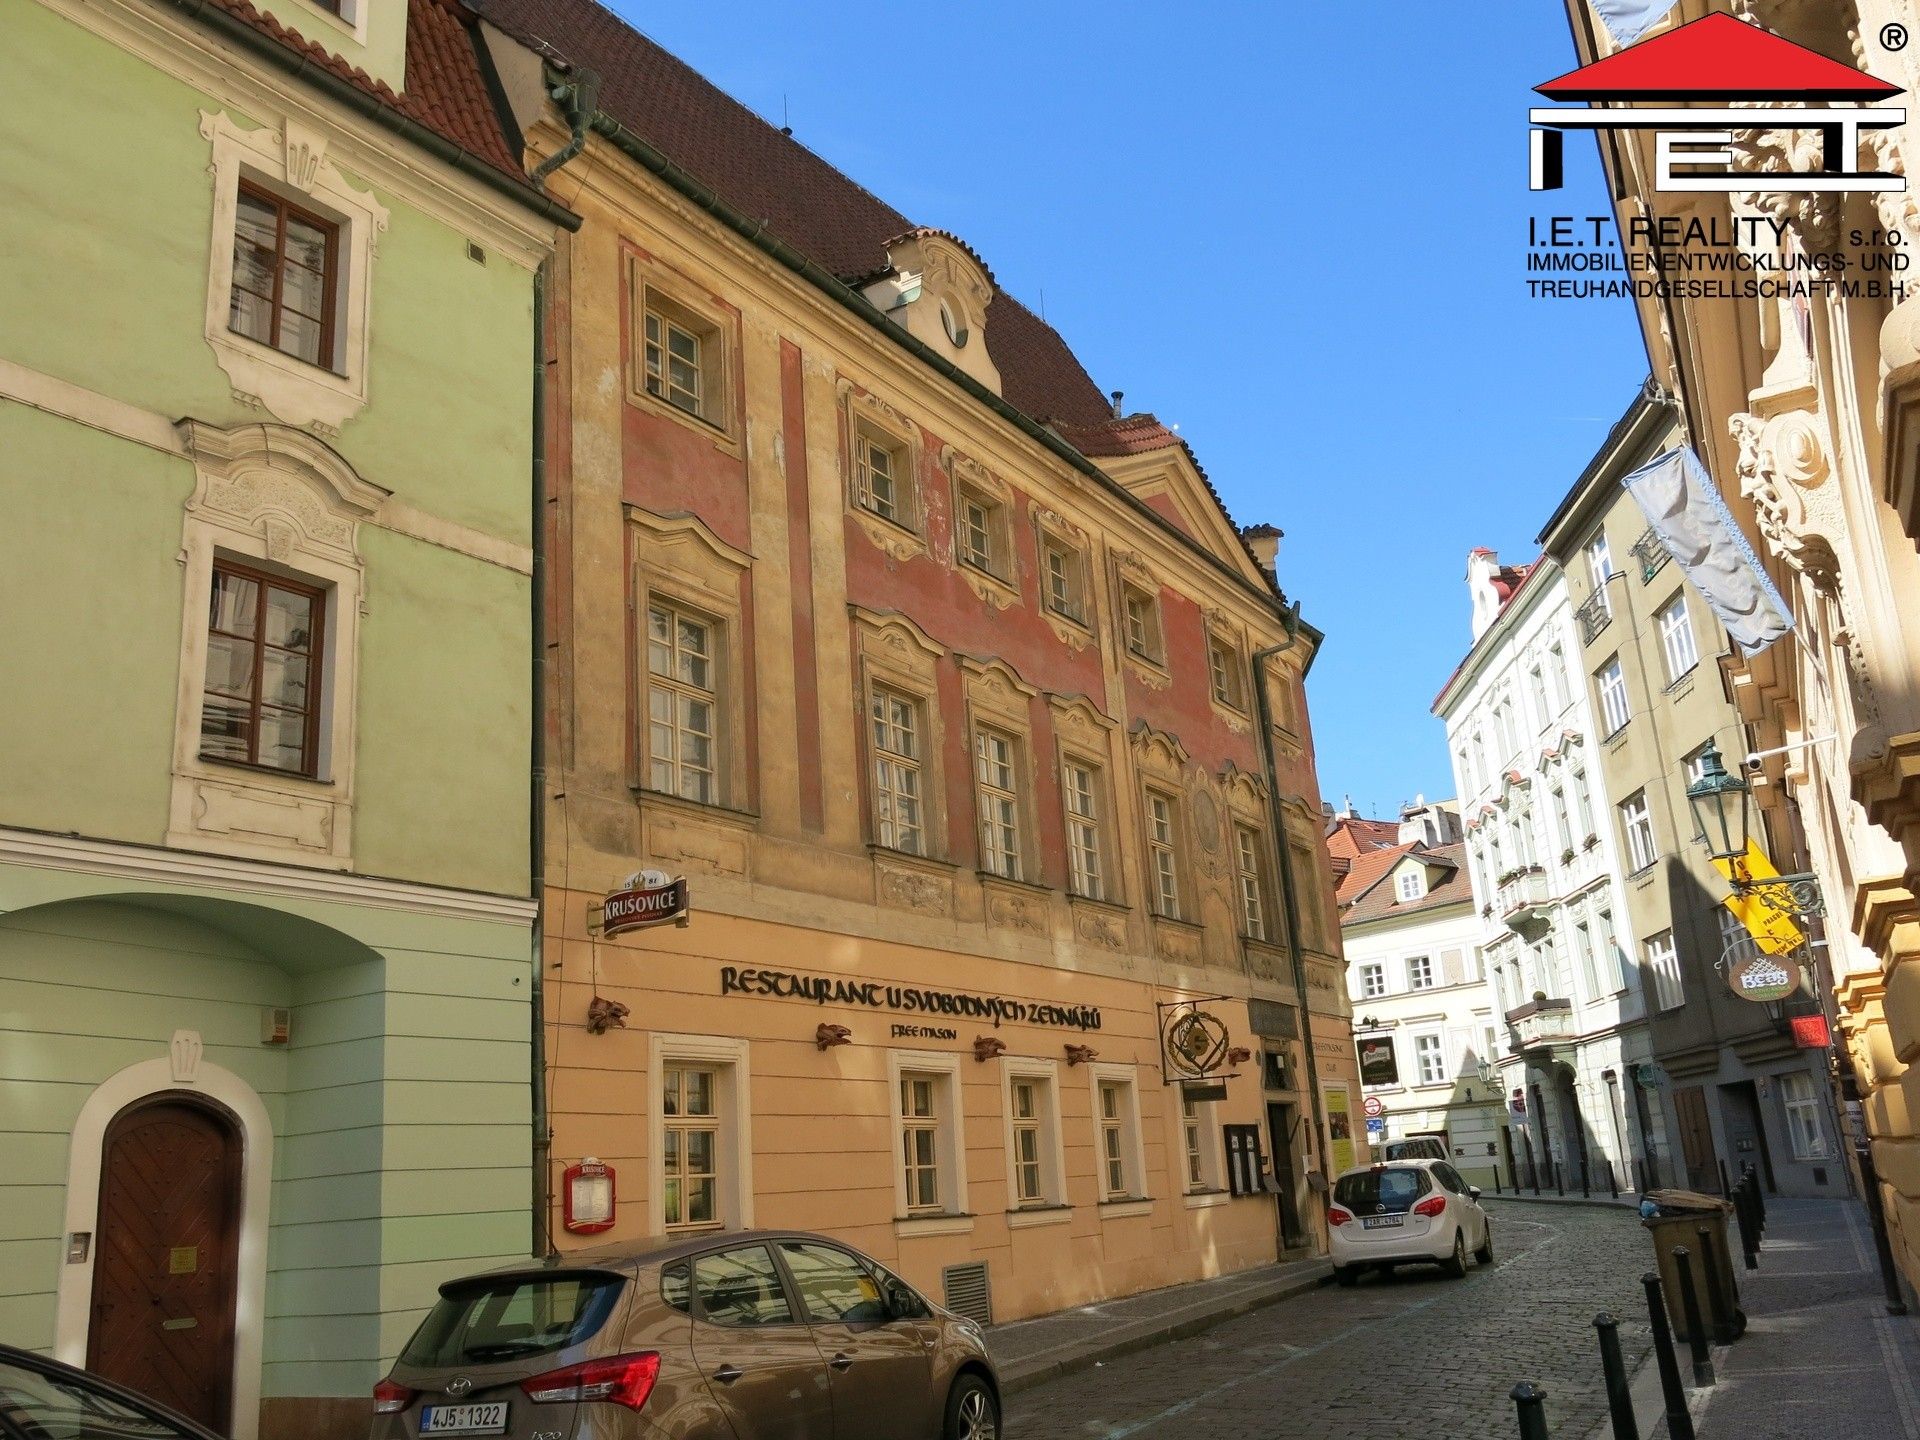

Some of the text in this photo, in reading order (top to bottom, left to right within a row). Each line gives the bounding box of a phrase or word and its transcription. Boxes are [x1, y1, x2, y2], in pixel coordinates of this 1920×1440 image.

[605, 891, 676, 921] KRUŠOVICE
[720, 966, 885, 1007] RESTAURANT
[886, 986, 900, 1009] U
[432, 1408, 457, 1428] 4J5
[467, 1405, 500, 1426] 1322
